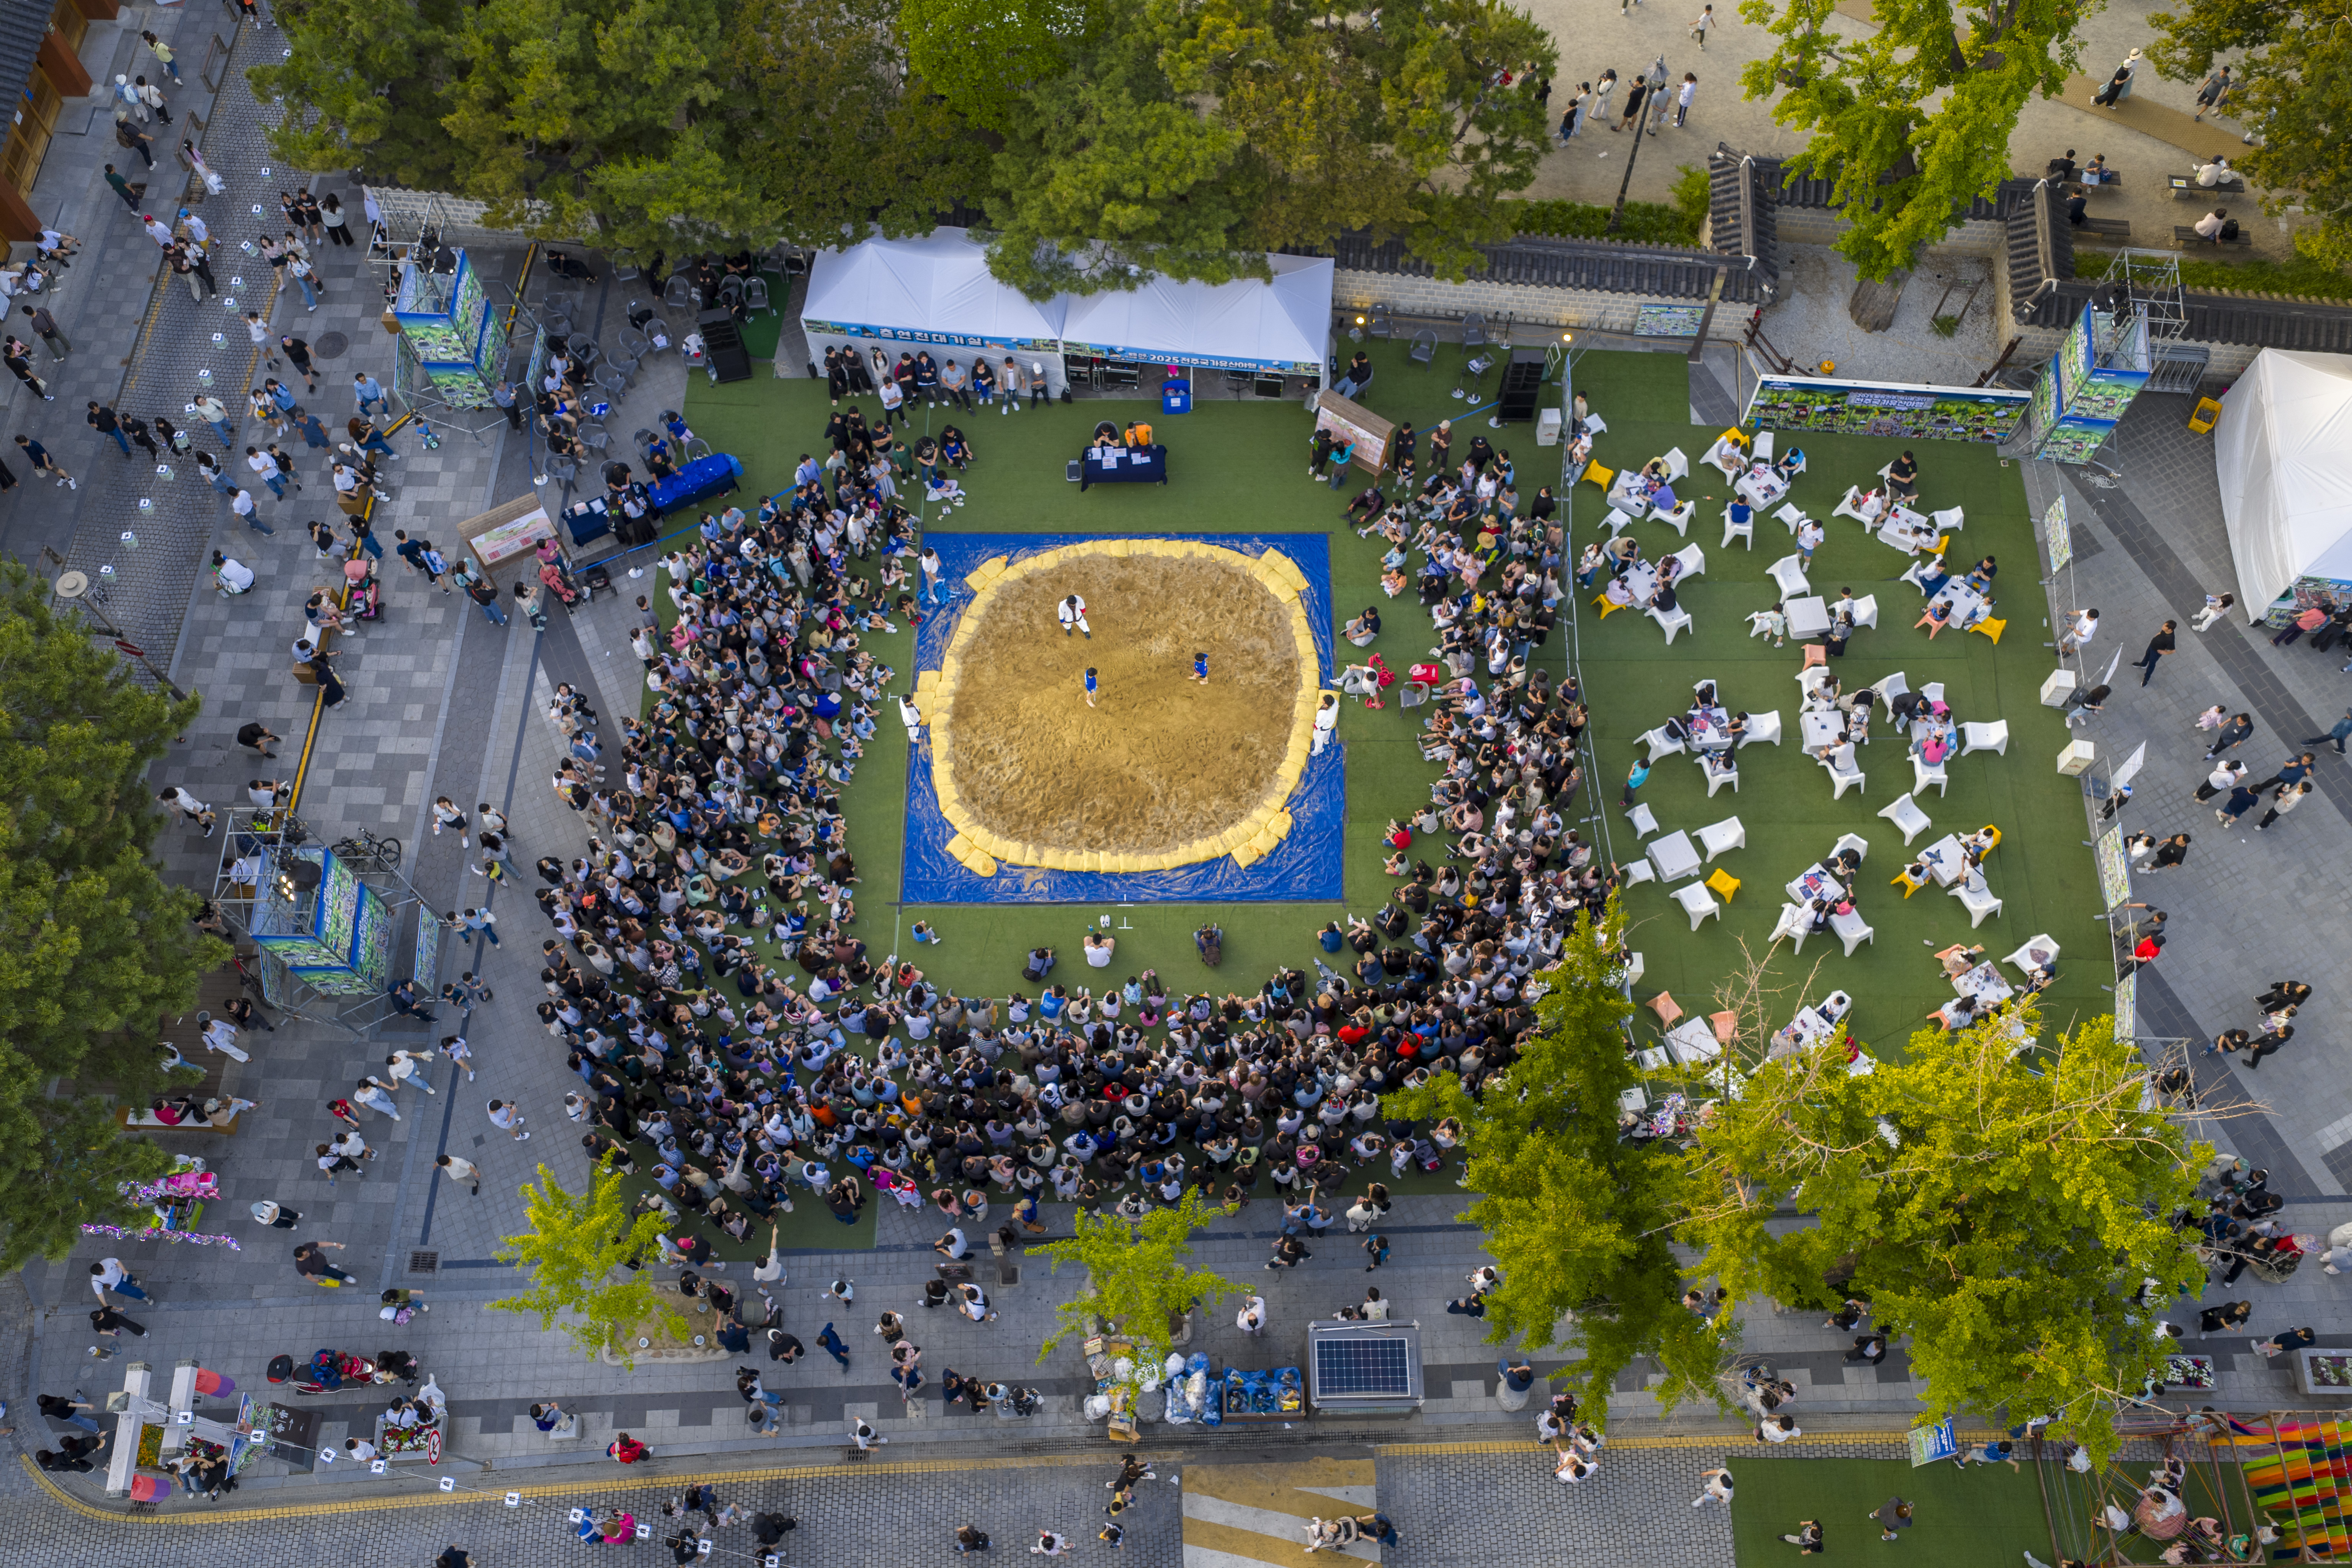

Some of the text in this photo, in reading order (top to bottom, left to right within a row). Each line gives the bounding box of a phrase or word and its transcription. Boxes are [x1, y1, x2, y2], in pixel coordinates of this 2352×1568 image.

[879, 328, 984, 347] 출연진대기실
[1150, 354, 1179, 364] 2025
[1181, 356, 1258, 369] 전주국가유산야행
[2324, 583, 2352, 591] 체험
